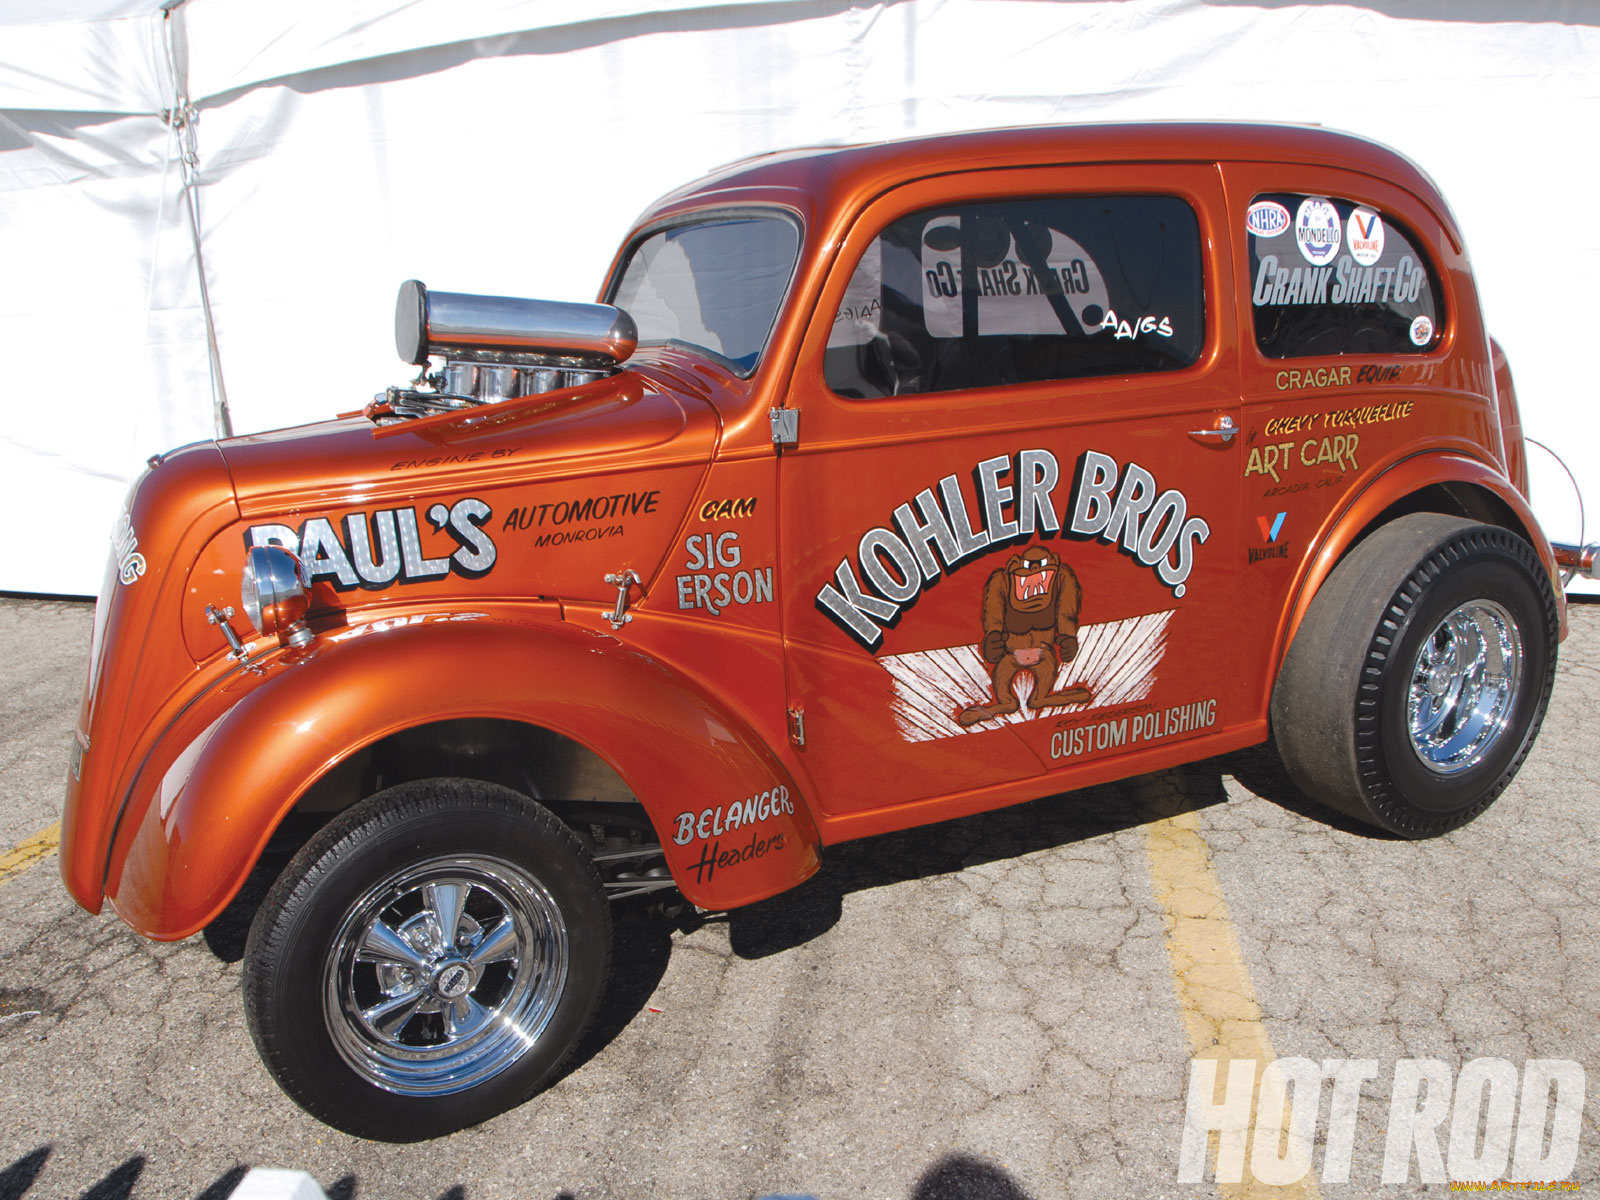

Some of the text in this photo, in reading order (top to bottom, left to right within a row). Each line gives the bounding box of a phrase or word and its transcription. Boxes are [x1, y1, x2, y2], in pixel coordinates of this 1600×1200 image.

[1251, 208, 1285, 230] NHRA
[1298, 226, 1340, 243] MONDELLO
[1253, 255, 1333, 306] CRANK
[1331, 255, 1395, 304] SHAFT
[1100, 309, 1174, 341] AA/GS
[1276, 366, 1352, 391] CRAGAR
[1264, 400, 1415, 438] CHEVY TORQUEFLITE
[390, 447, 523, 472] ENGINE BY
[1243, 433, 1361, 485] ART CARR
[502, 490, 661, 533] AUTOMOTIVE
[699, 496, 758, 522] CAM
[534, 524, 625, 548] MONROVIA
[685, 530, 742, 571] SIG
[815, 448, 1060, 654] KOHLER
[1248, 540, 1291, 566] VALVOLINE
[676, 567, 774, 616] ERSON
[1050, 718, 1129, 760] CUSTOM
[1131, 699, 1217, 743] POLISHING
[672, 785, 794, 846] BELANGER
[686, 832, 784, 885] Headers
